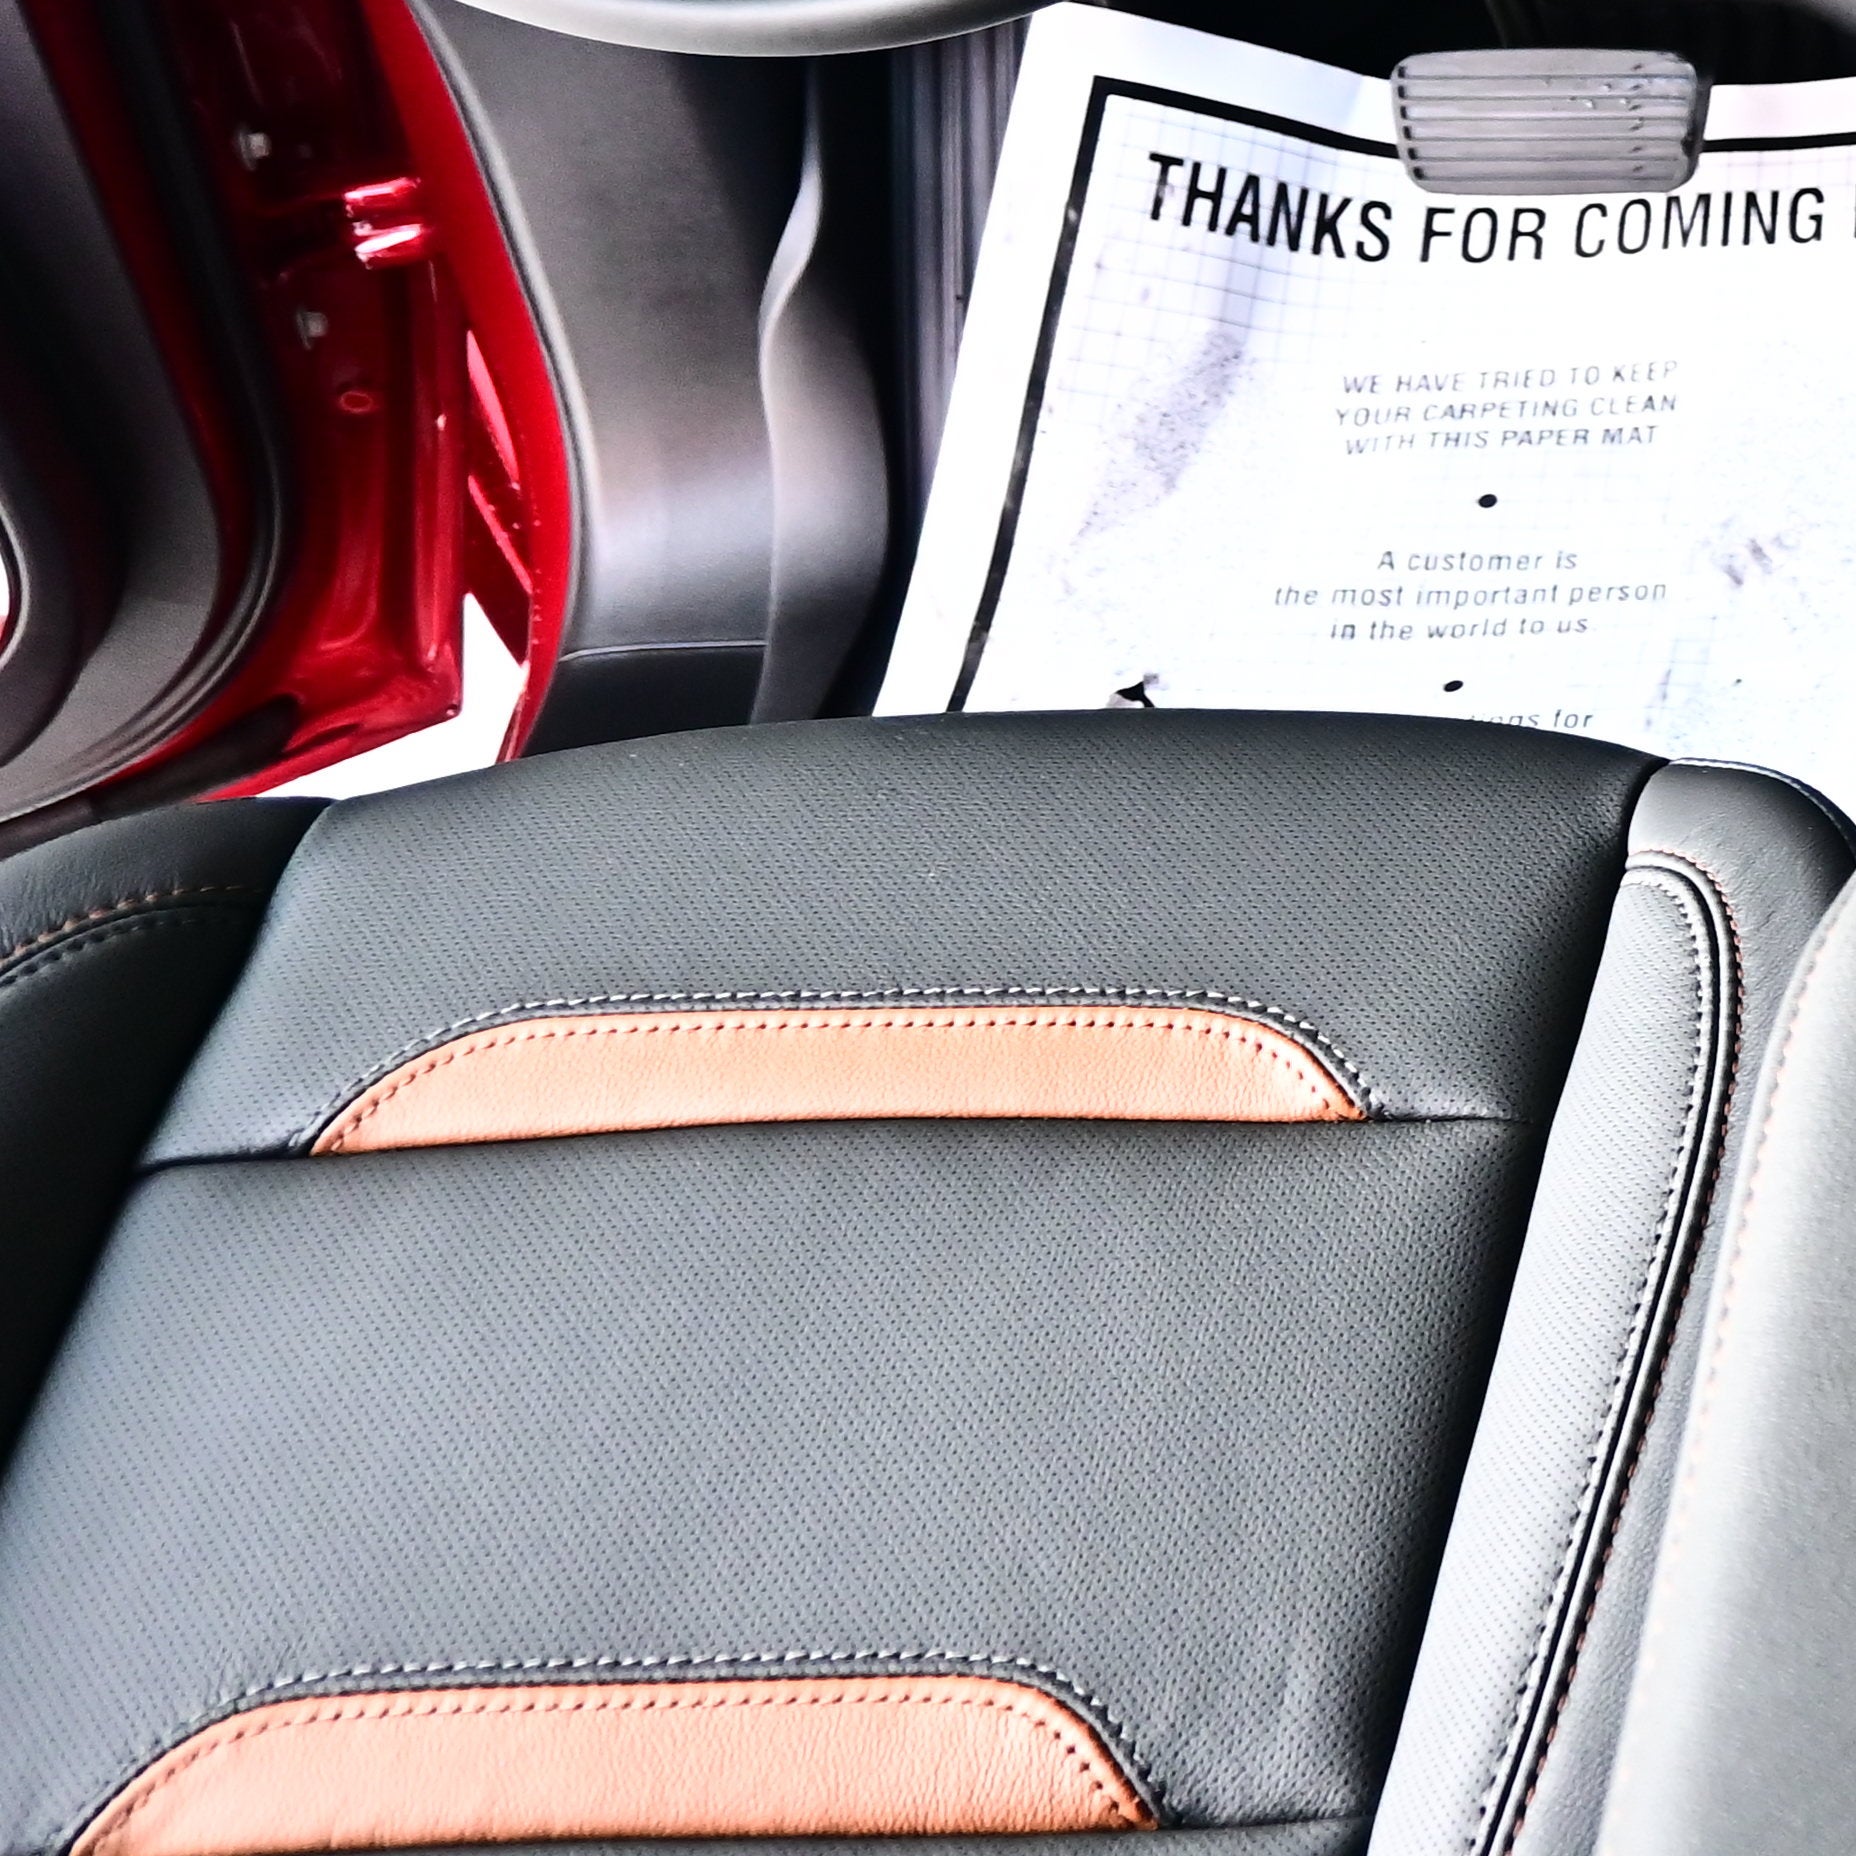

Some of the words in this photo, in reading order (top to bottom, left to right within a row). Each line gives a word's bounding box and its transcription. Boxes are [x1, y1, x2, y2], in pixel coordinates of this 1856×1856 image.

[1149, 152, 1392, 262] THANKS
[1420, 206, 1546, 263] FOR
[1575, 188, 1825, 258] COMING
[1343, 374, 1382, 394] WE
[1395, 372, 1465, 393] HAVE
[1480, 368, 1556, 390] TRIED
[1571, 365, 1600, 386] TO
[1612, 360, 1678, 383] KEEP
[1335, 406, 1411, 427] YOUR
[1423, 398, 1578, 421] CARPETING
[1590, 394, 1678, 417] CLEAN
[1345, 433, 1415, 456] WITH
[1430, 430, 1490, 449] THIS
[1501, 428, 1590, 447] PAPER
[1601, 425, 1659, 445] MAT
[1377, 550, 1396, 571] A
[1407, 550, 1543, 572] customer
[1556, 549, 1578, 571] is
[1274, 585, 1319, 607] the
[1331, 585, 1404, 607] most
[1415, 584, 1558, 611] important
[1569, 581, 1667, 606] person
[1330, 620, 1356, 641] in
[1369, 619, 1414, 641] the
[1427, 618, 1507, 640] world
[1519, 617, 1545, 636] to
[1553, 708, 1594, 729] for
